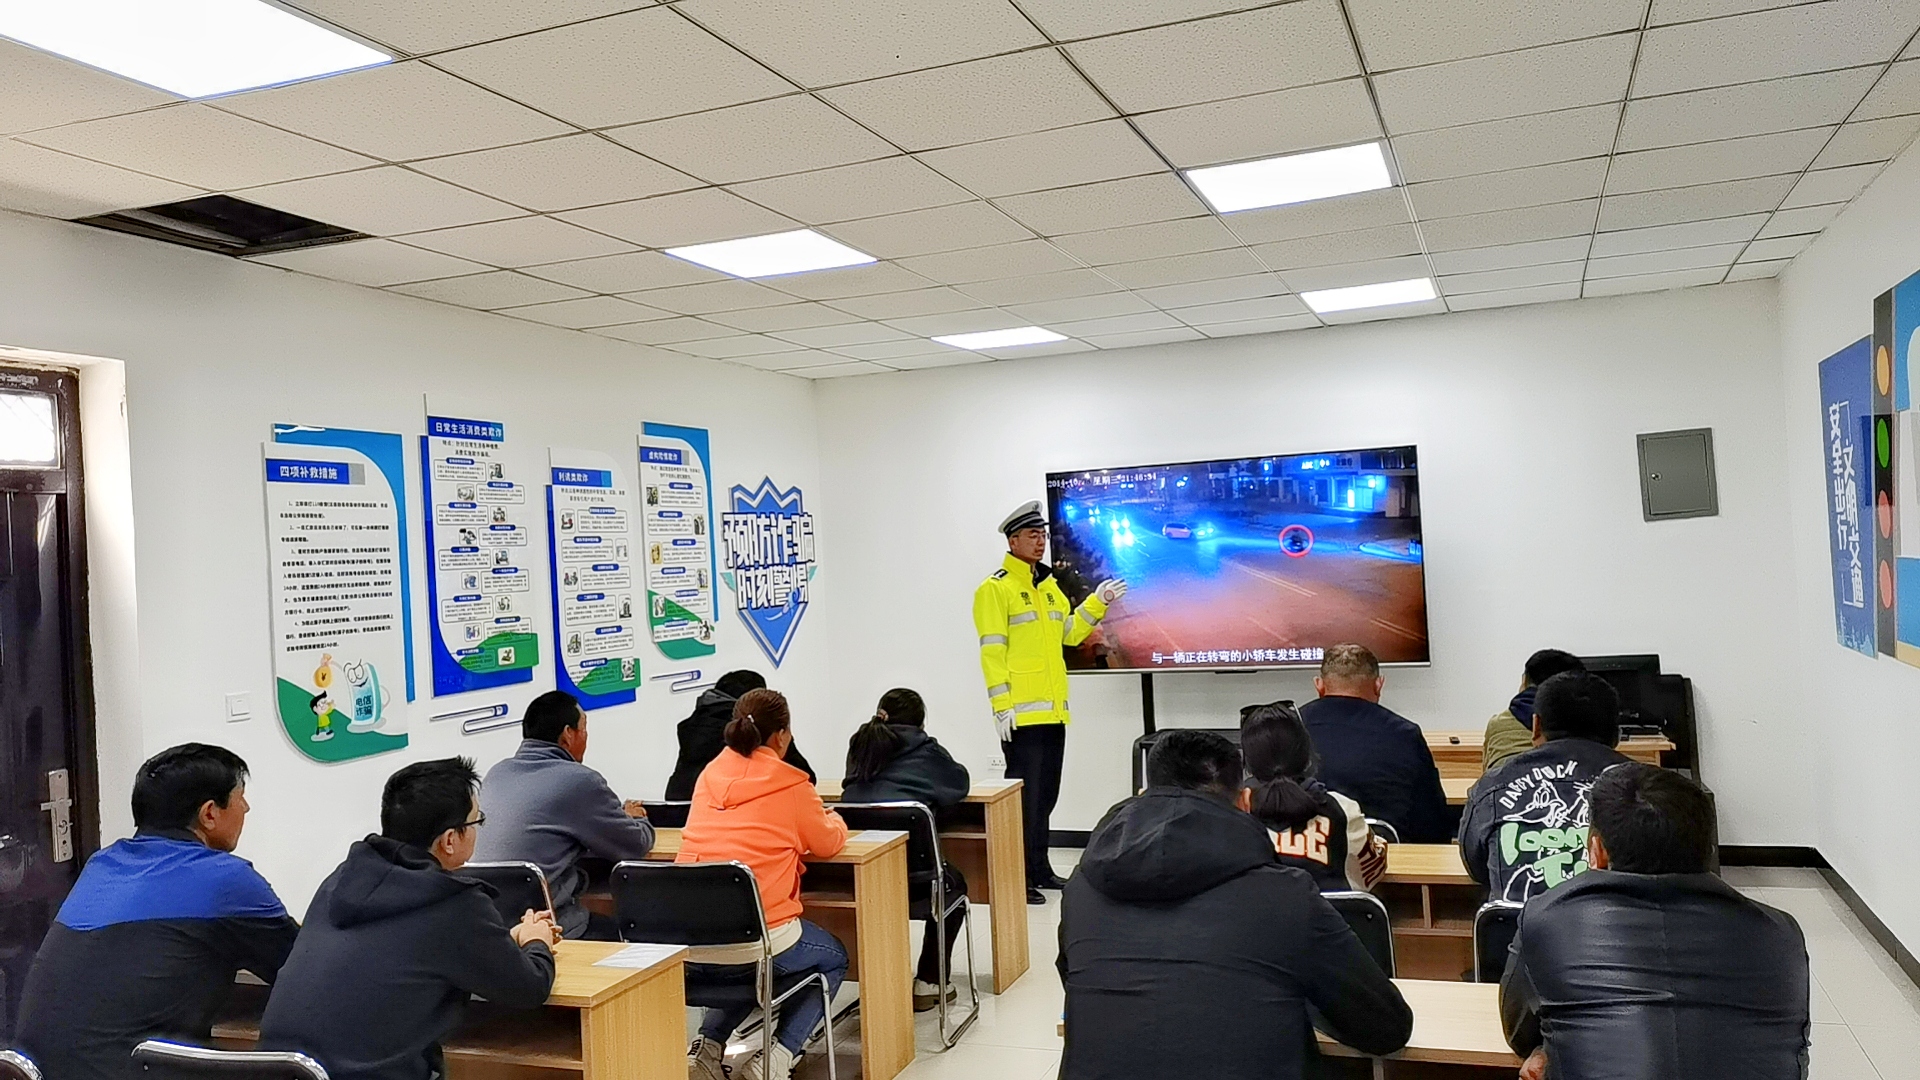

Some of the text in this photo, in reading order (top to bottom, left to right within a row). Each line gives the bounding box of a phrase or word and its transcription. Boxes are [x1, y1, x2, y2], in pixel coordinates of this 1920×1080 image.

[279, 465, 338, 480] 四项补救措施
[722, 512, 815, 569] 预防诈骗
[736, 562, 809, 611] 时刻警惕
[1151, 647, 1325, 665] 与一辆正在转弯的小轿车发生碰撞
[1532, 760, 1578, 781] DUCK
